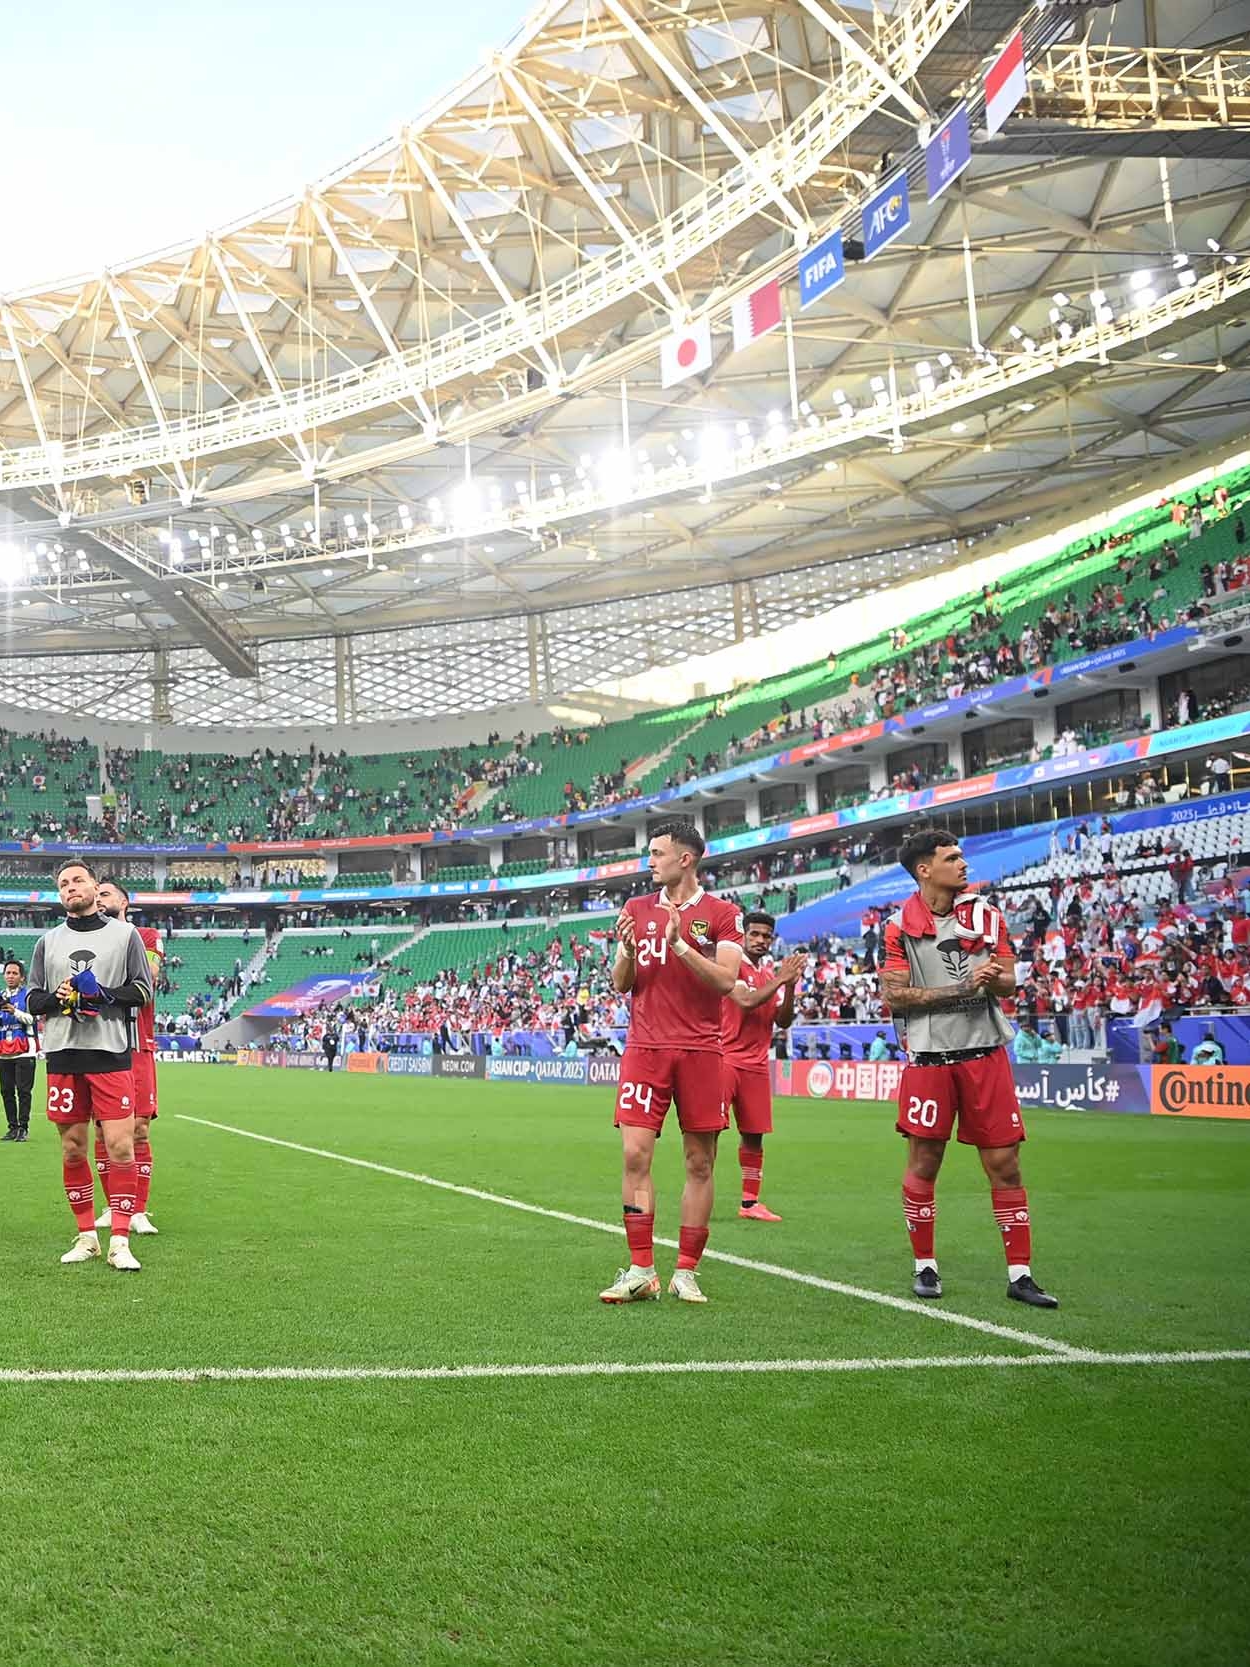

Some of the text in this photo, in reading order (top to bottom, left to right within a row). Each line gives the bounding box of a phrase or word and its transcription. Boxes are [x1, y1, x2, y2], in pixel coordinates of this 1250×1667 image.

[869, 196, 902, 241] AFC
[805, 252, 837, 289] FIFA
[637, 937, 668, 967] 24
[388, 1056, 408, 1072] CREDIT
[441, 1060, 476, 1072] NEOM.COM
[490, 1059, 513, 1076] ASIAN
[513, 1061, 530, 1077] CUP
[535, 1061, 562, 1081] QATAR
[48, 1086, 75, 1113] 23
[619, 1082, 653, 1114] 24
[907, 1096, 938, 1128] 20
